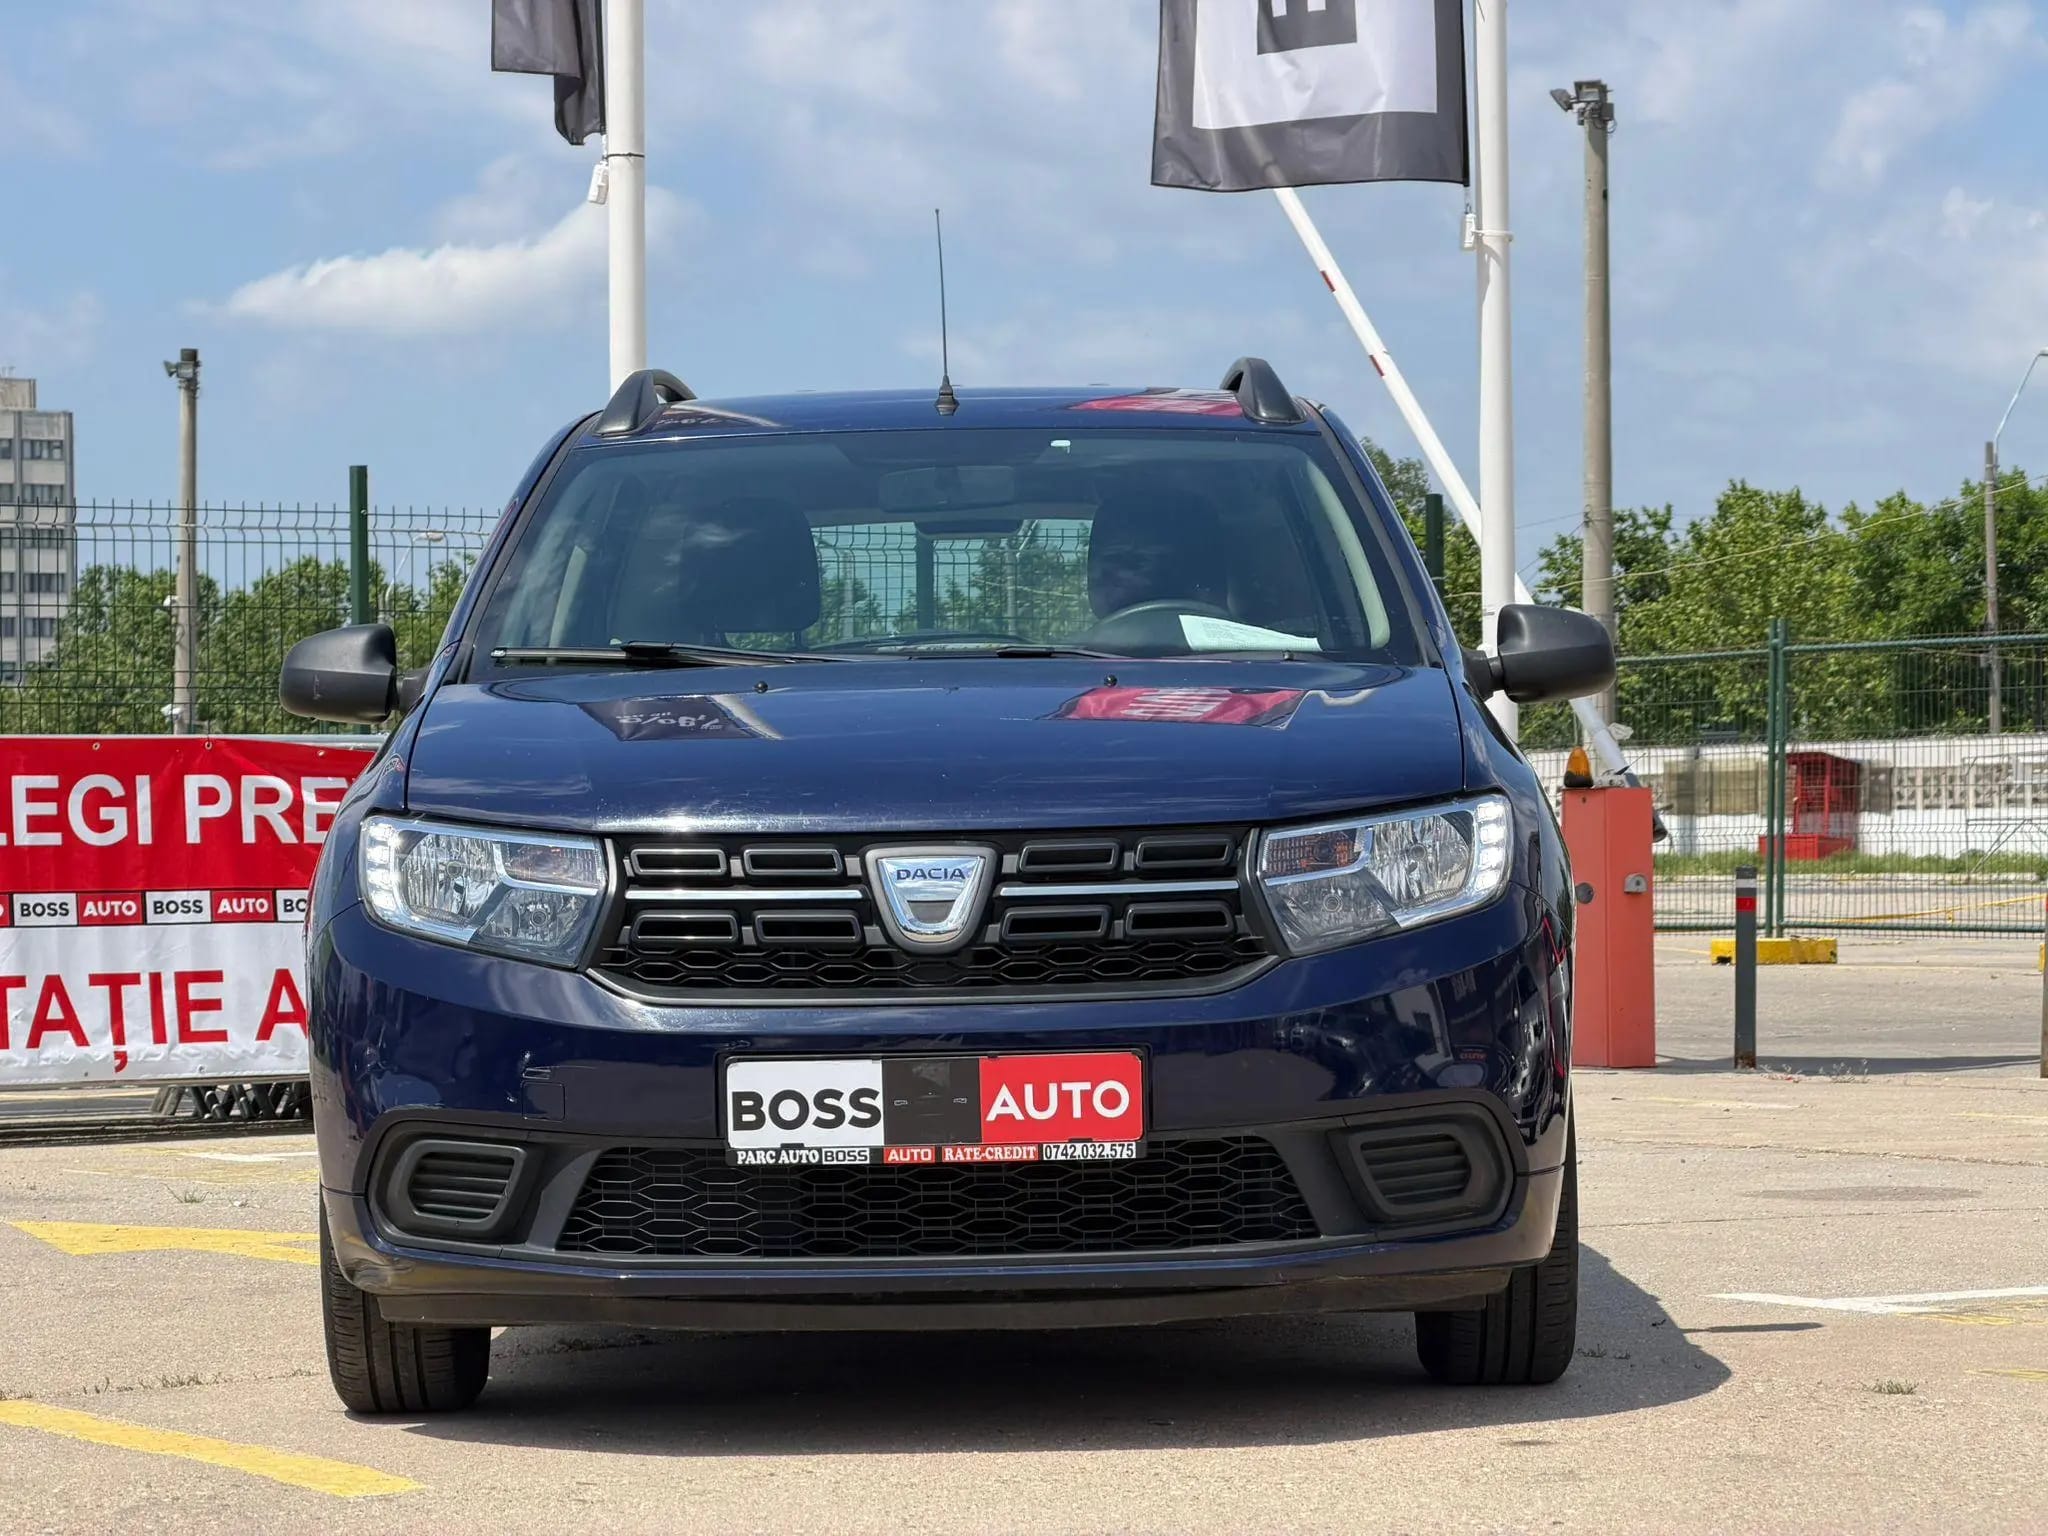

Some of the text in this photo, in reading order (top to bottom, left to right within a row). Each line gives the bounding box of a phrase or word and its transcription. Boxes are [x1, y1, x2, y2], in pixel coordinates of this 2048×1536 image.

[896, 868, 966, 880] DACIA
[20, 902, 69, 917] BOSS
[83, 900, 138, 917] AUTO
[153, 899, 203, 914] BOSS
[217, 898, 269, 914] AUTO
[732, 1080, 1130, 1131] BOSS AUTO
[737, 1143, 1134, 1165] PARC AUTO BOSS AUTO RATE-CREDIT 0742.032.575
